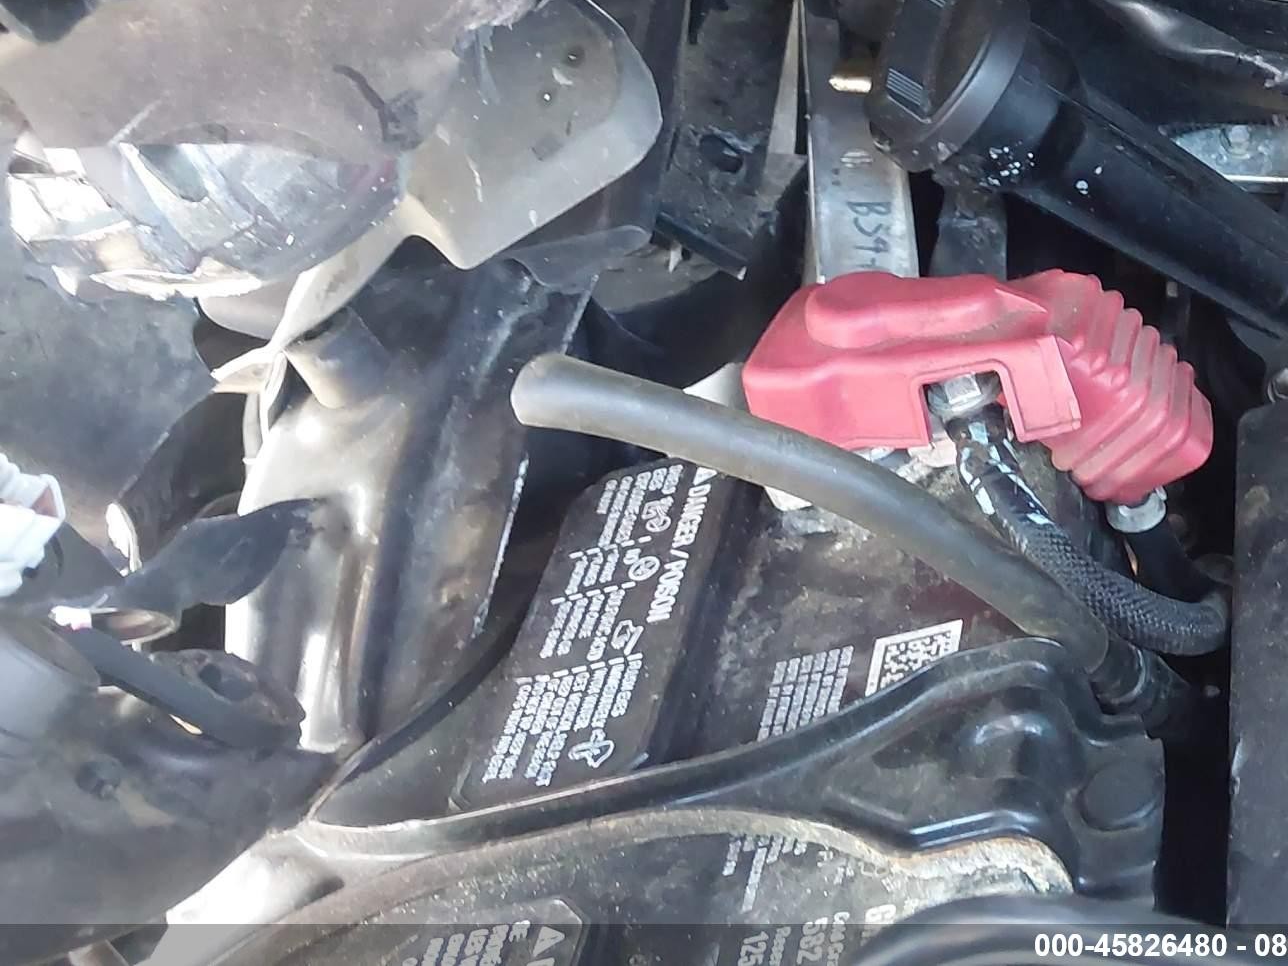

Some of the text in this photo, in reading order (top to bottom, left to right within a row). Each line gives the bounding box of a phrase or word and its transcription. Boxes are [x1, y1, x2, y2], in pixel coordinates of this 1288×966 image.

[672, 484, 711, 547] DANGER
[646, 559, 688, 623] POISON
[796, 917, 829, 965] 582
